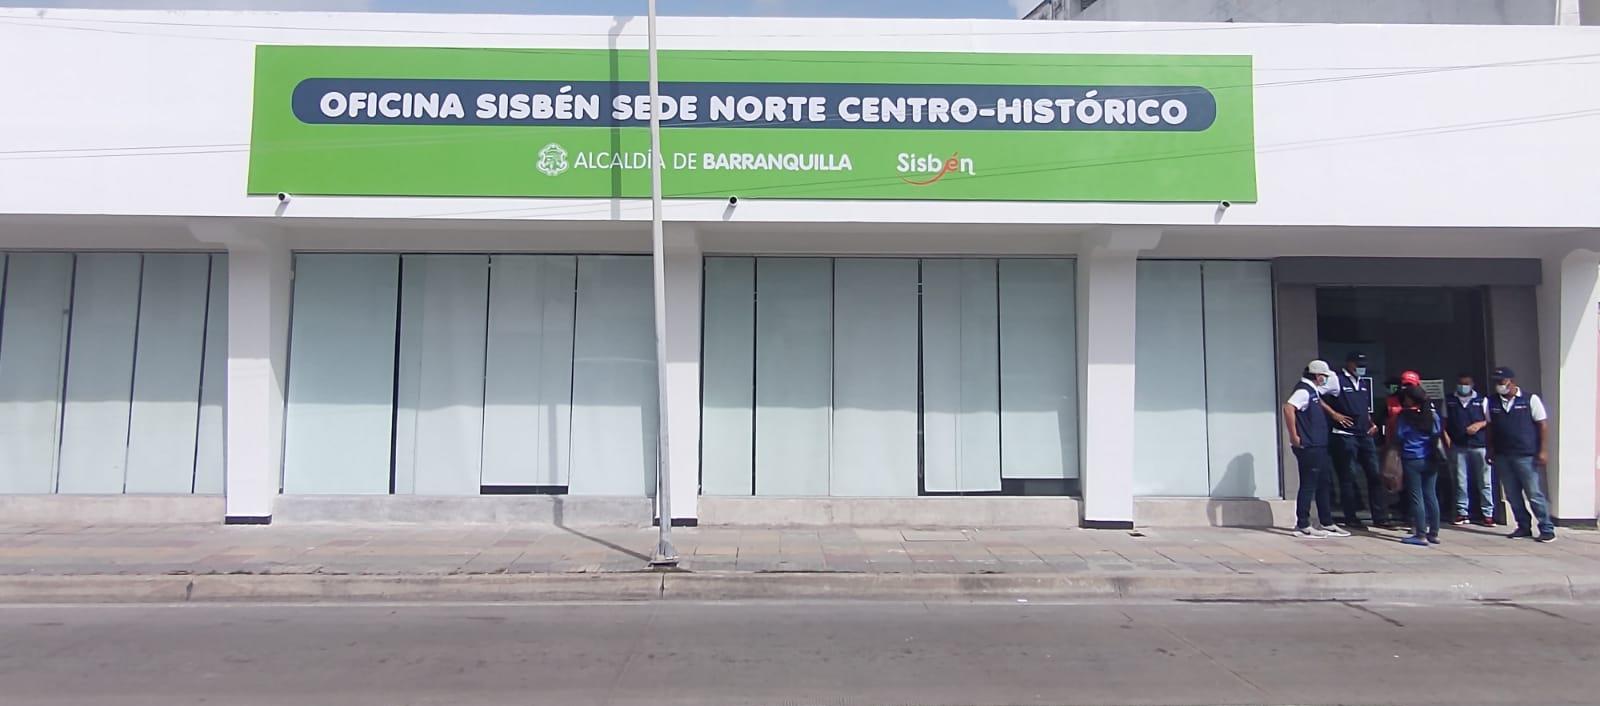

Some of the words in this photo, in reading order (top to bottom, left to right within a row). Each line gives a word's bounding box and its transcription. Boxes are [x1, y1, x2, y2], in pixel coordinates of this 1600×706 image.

[319, 91, 465, 119] OFICINA
[475, 85, 600, 120] SISBÉN
[612, 94, 698, 121] SEDE
[709, 95, 826, 122] NORTE
[838, 89, 1188, 125] CENTRO-HISTÓRICO
[673, 152, 697, 170] DE
[702, 153, 853, 172] BARRANQUILLA
[896, 150, 977, 179] Sisbén
